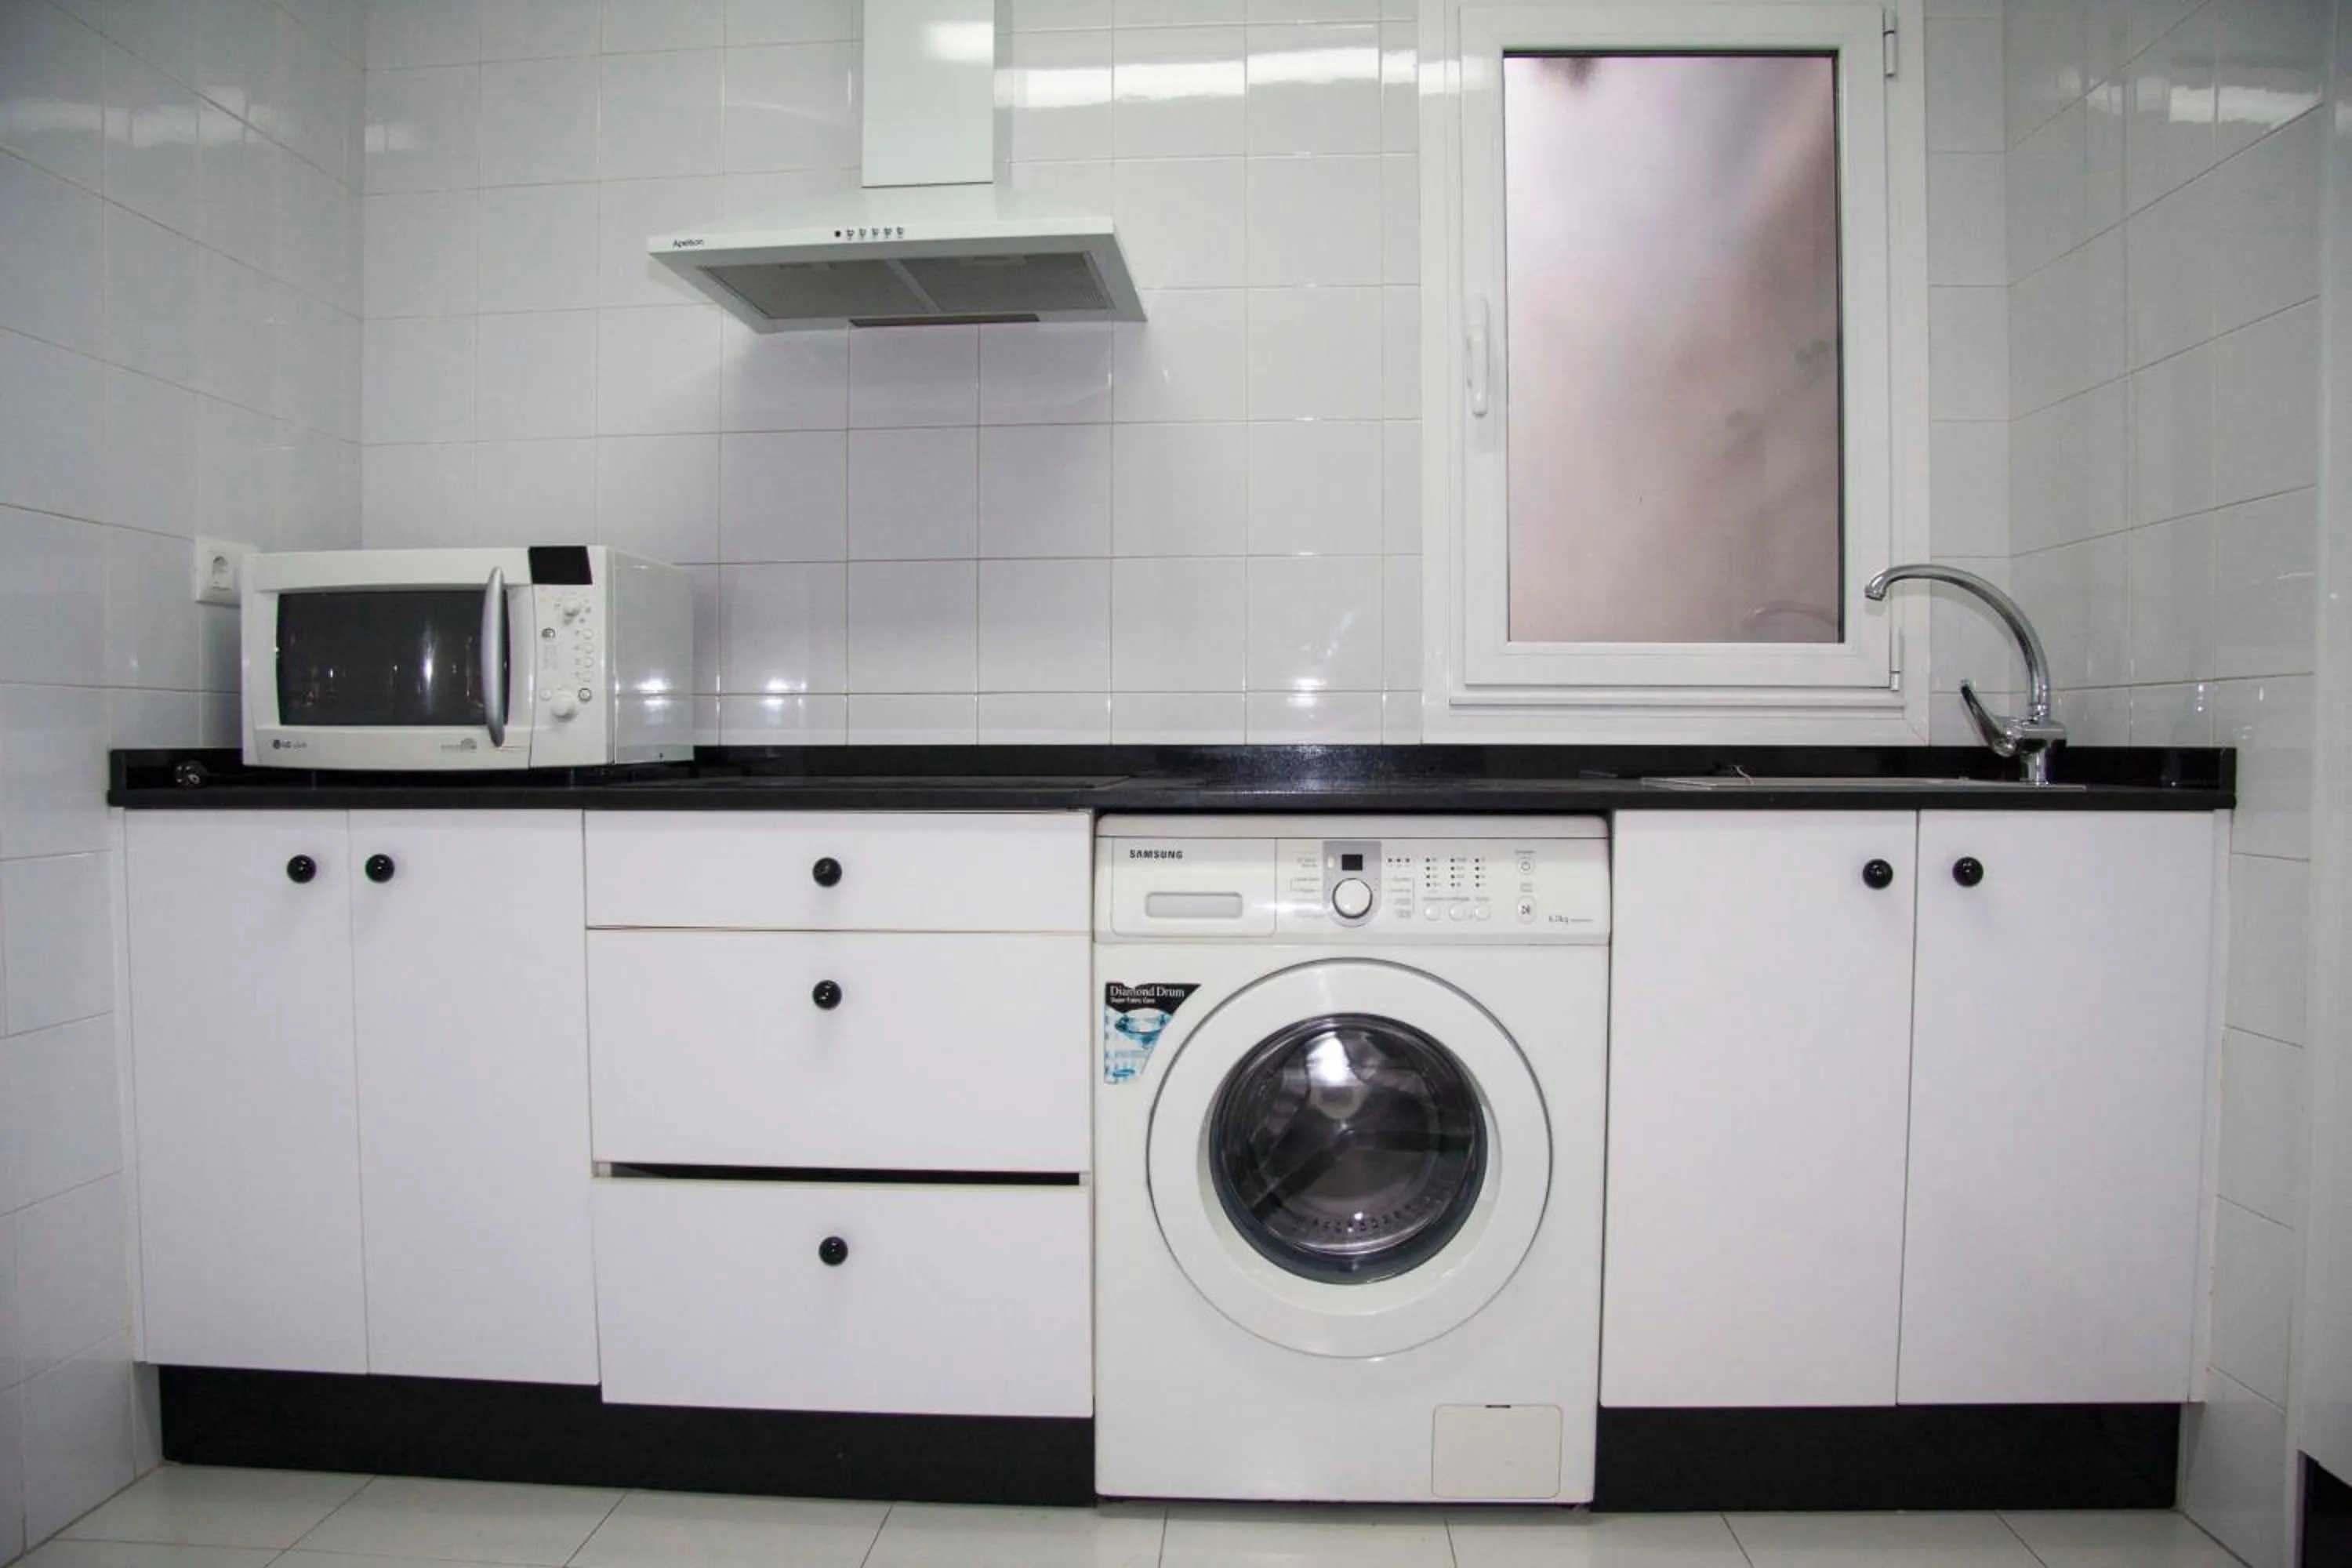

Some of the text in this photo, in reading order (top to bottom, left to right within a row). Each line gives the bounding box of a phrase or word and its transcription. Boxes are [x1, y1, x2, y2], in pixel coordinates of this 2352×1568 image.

[1129, 849, 1184, 860] SAMSUNG
[1110, 985, 1185, 997] Diamond Drum
